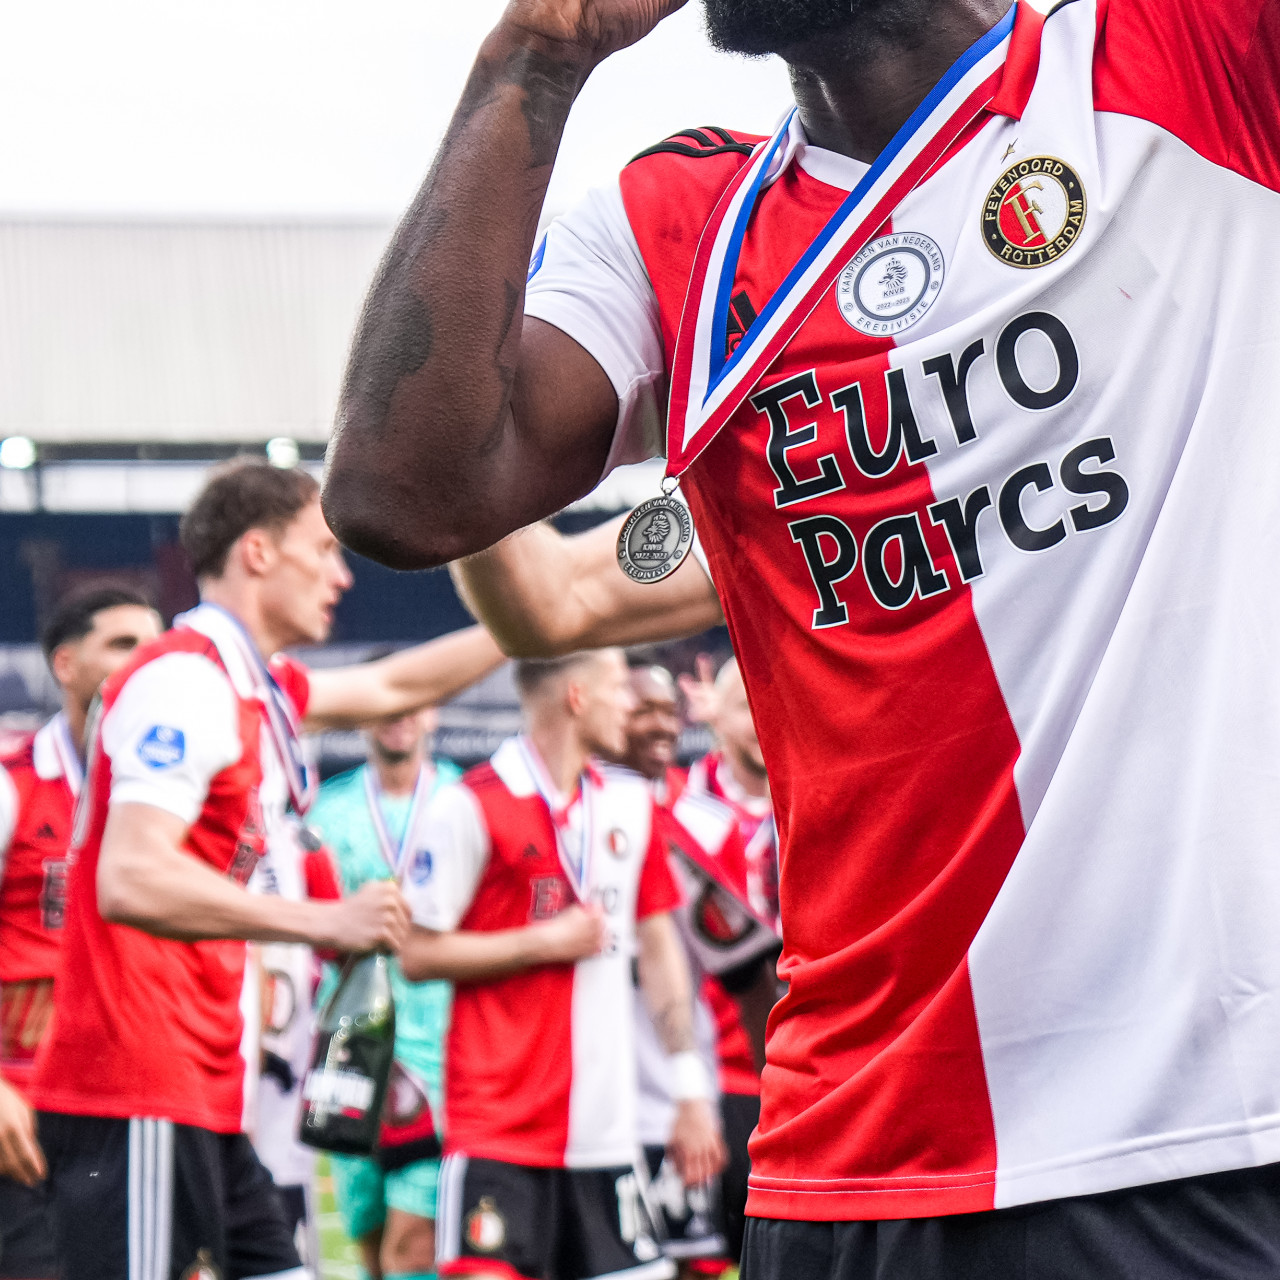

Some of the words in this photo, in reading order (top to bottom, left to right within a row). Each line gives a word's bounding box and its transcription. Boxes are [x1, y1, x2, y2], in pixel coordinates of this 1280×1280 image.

[985, 159, 1063, 220] FEYENOORD
[1000, 200, 1083, 265] ROTTERDAM
[841, 246, 875, 293] KAMPIOEN
[877, 237, 899, 249] VAN
[902, 236, 941, 271] NEDERLAND
[883, 286, 905, 297] KNVB
[856, 301, 928, 332] EREDIVISIE
[749, 311, 1080, 508] Euro
[788, 435, 1130, 630] Parcs
